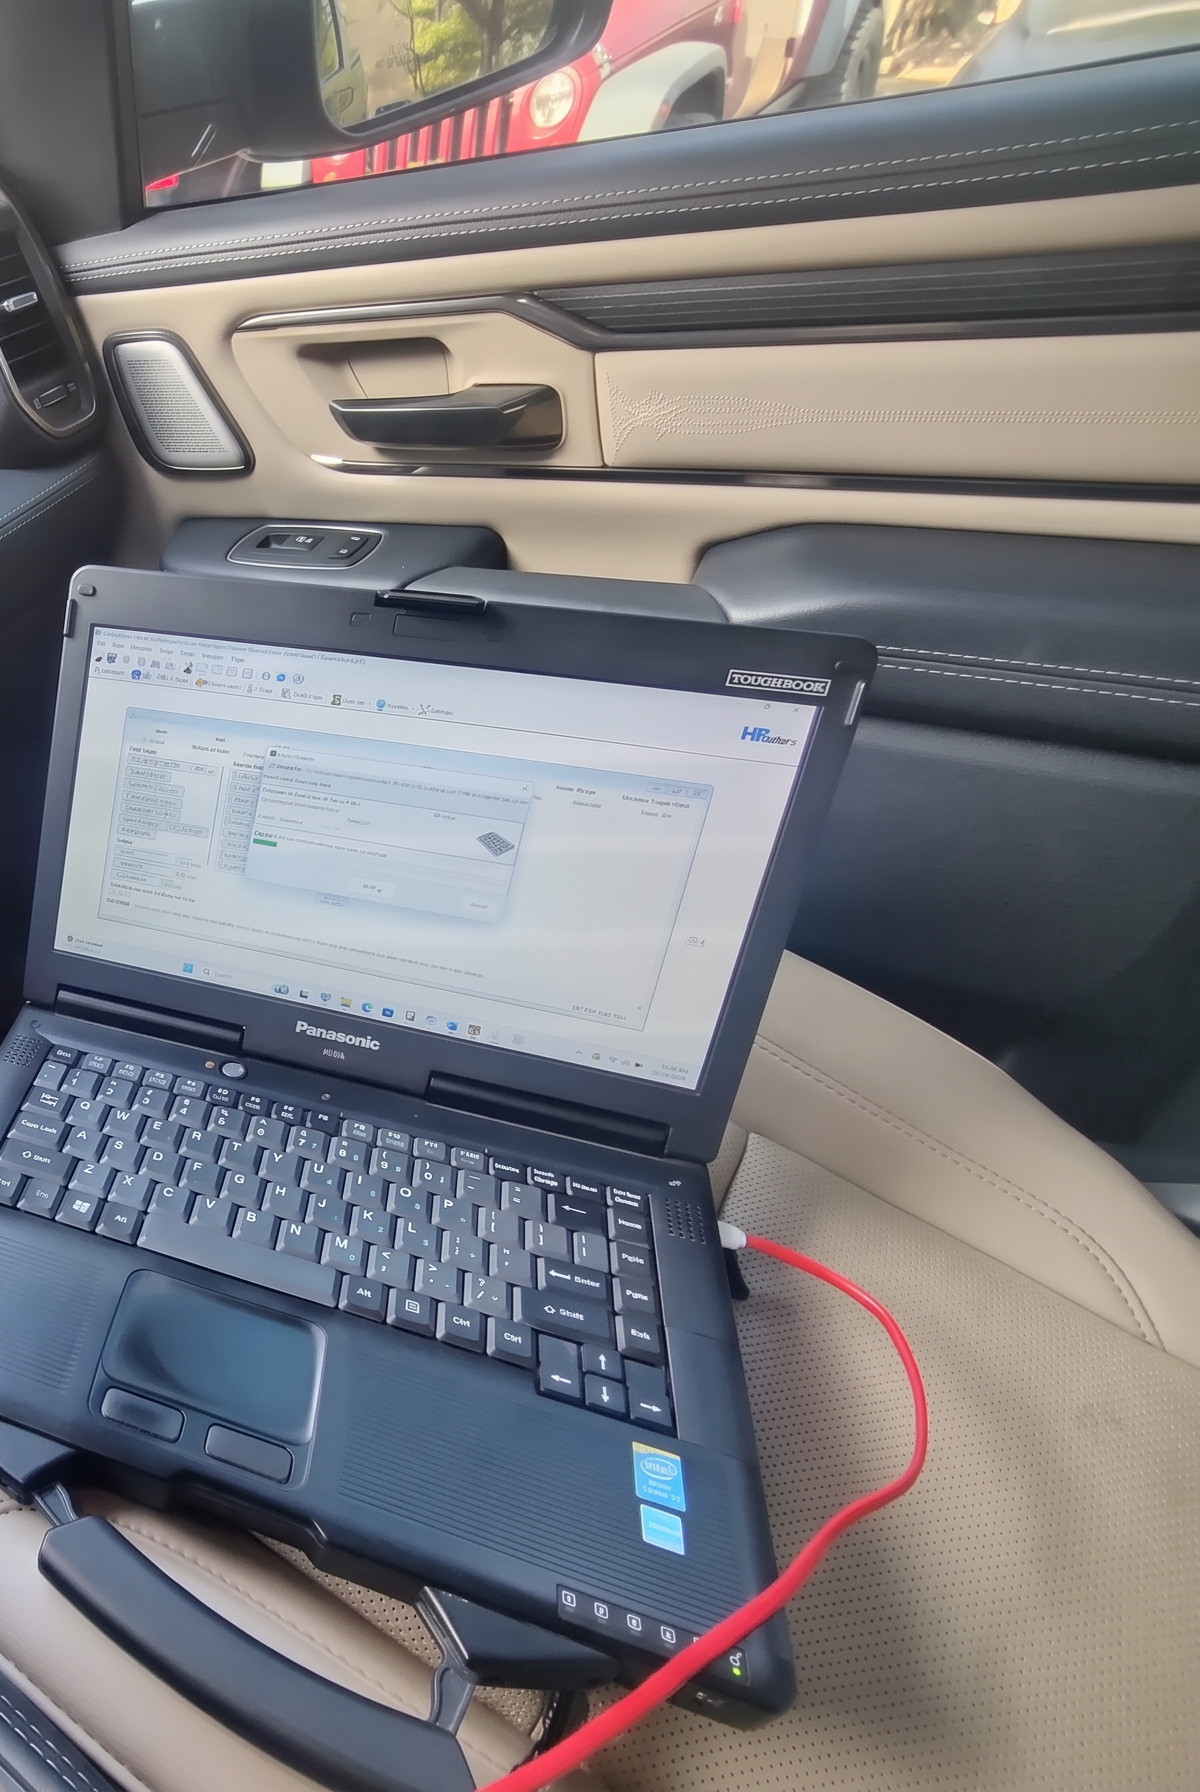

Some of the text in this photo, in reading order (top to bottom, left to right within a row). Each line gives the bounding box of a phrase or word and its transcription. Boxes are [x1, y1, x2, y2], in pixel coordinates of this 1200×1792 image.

[731, 674, 826, 692] TOUGHBOOK
[295, 1020, 381, 1051] Panasonic
[80, 1101, 91, 1111] Q
[179, 1107, 188, 1115] 4
[116, 1110, 131, 1121] W
[153, 1121, 163, 1131] E
[76, 1130, 87, 1140] A
[192, 1131, 202, 1141] R
[114, 1140, 124, 1150] S
[232, 1142, 242, 1151] T
[298, 1139, 306, 1147] 7
[153, 1151, 164, 1161] D
[273, 1153, 283, 1163] Y
[83, 1164, 95, 1174] Z
[193, 1162, 203, 1171] F
[313, 1163, 324, 1174] U
[122, 1175, 134, 1186] X
[234, 1174, 245, 1184] G
[163, 1187, 174, 1197] C
[275, 1185, 287, 1196] H
[400, 1187, 412, 1198] O
[205, 1198, 216, 1209] V
[318, 1198, 326, 1208] J
[444, 1199, 454, 1209] P
[246, 1211, 257, 1222] B
[363, 1210, 374, 1221] K
[290, 1224, 301, 1236] N
[408, 1222, 417, 1233] L
[335, 1236, 348, 1249] M
[356, 1287, 372, 1298] Alt
[453, 1316, 470, 1327] Ctrl
